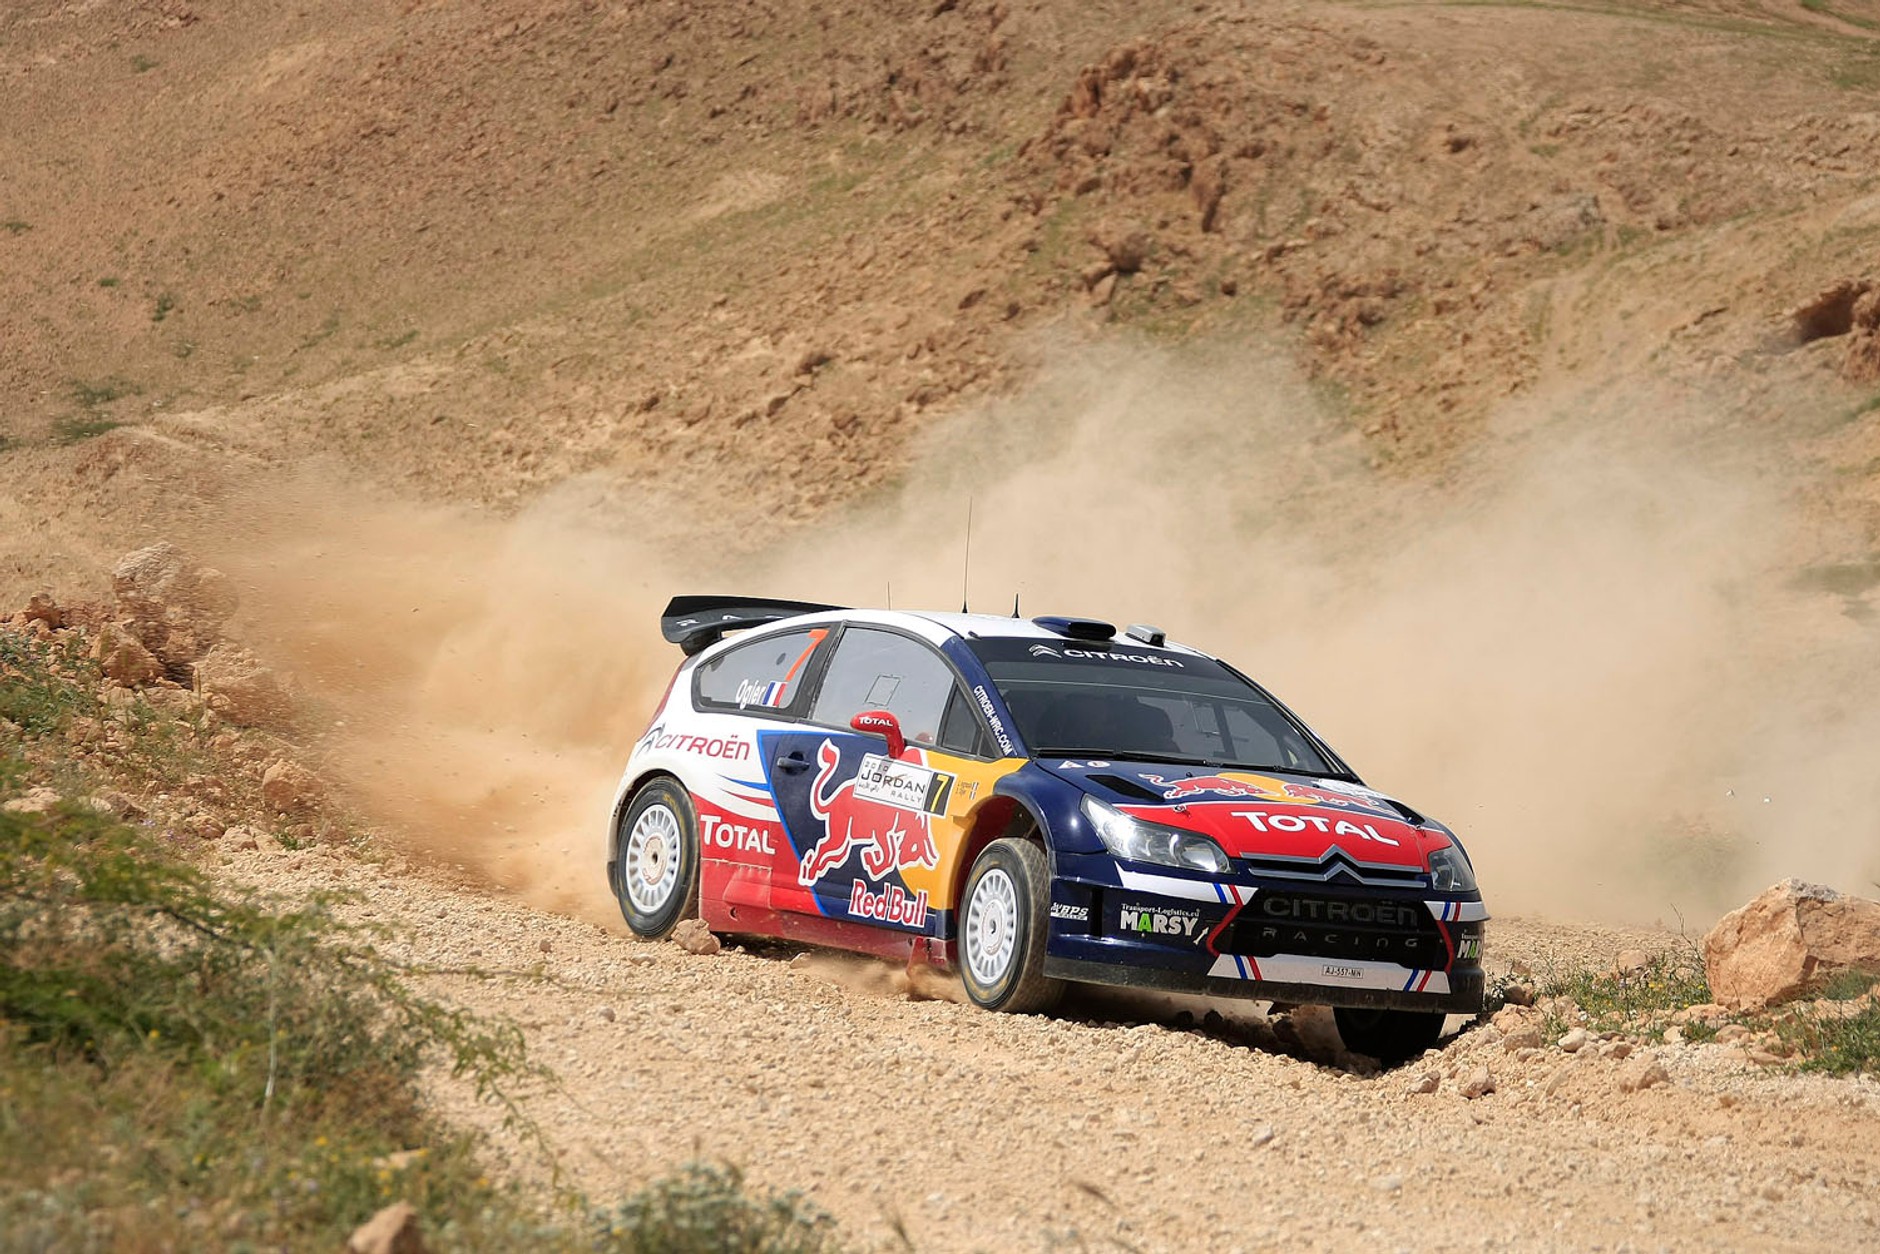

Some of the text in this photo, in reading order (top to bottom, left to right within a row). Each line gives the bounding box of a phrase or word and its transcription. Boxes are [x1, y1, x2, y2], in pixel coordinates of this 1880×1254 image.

[807, 629, 830, 682] 7
[735, 679, 766, 710] Ogier
[859, 716, 894, 727] TOTAL
[974, 685, 1013, 756] CITROEN-WRC.COM
[654, 734, 751, 761] CITROËN
[864, 761, 889, 772] 2010
[861, 770, 926, 794] JORDAN
[930, 774, 950, 812] 7
[891, 790, 923, 803] RALLY
[700, 815, 776, 855] TOTAL
[1230, 811, 1400, 846] TOTAL
[1120, 911, 1199, 936] MARSY
[1262, 927, 1419, 948] RACING
